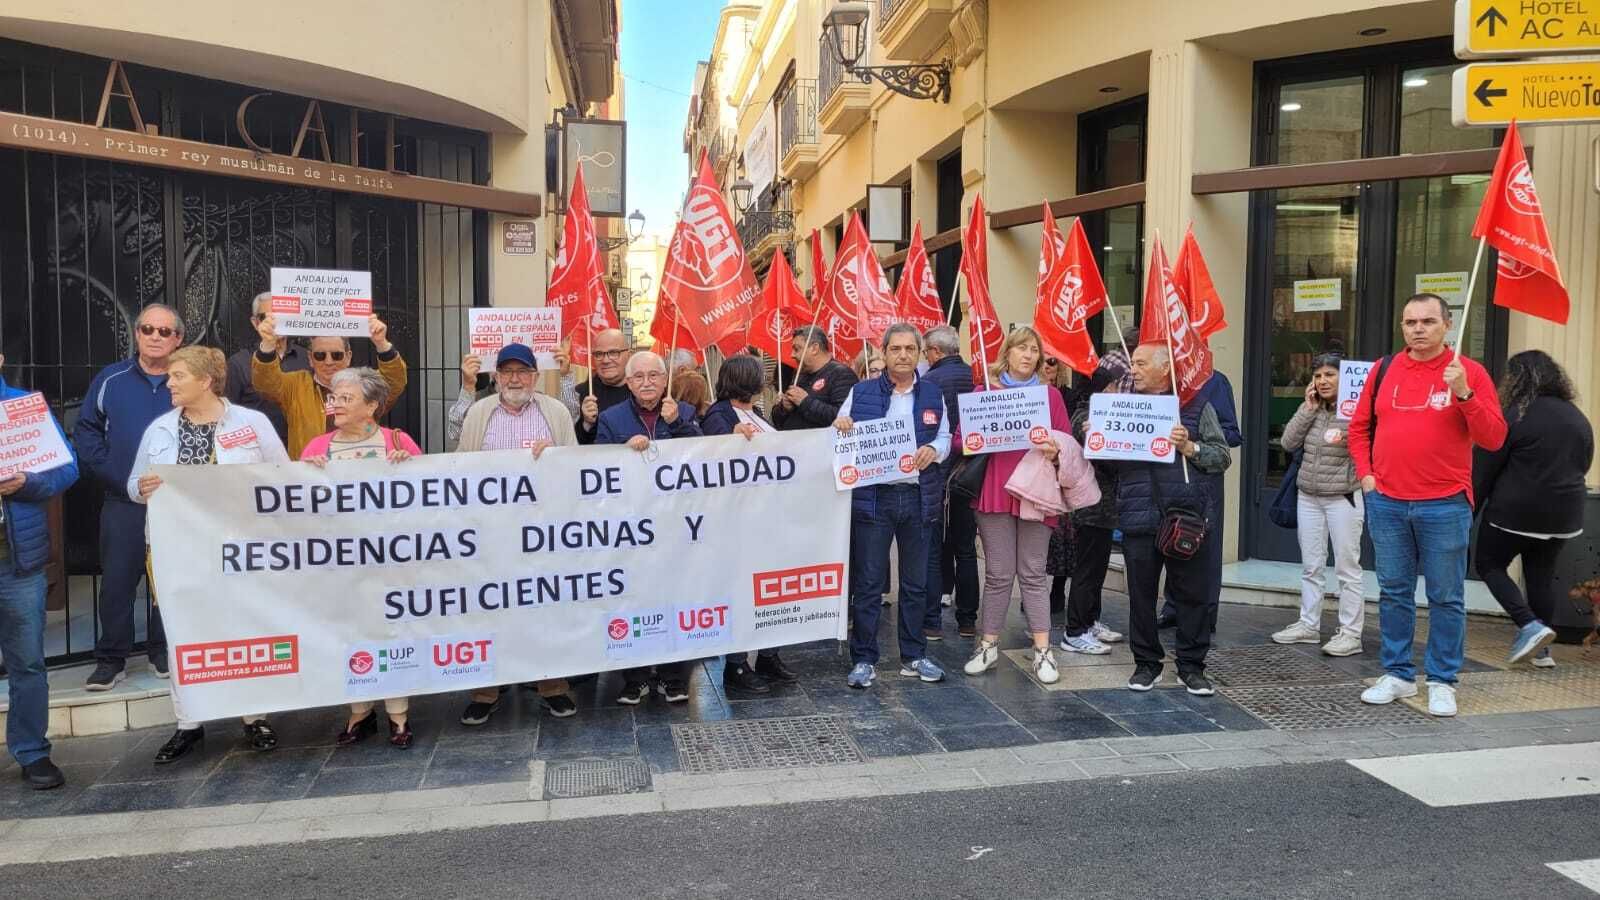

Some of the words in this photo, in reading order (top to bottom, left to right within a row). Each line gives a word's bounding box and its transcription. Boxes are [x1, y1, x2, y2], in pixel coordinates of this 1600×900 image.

[1520, 0, 1588, 15] HOTEL
[1520, 18, 1564, 39] AC
[1523, 75, 1556, 83] HOTEL
[12, 123, 90, 147] (1014).
[105, 137, 169, 158] Primer
[181, 150, 211, 166] rey
[220, 156, 295, 176] musulmán
[304, 167, 321, 180] de
[330, 169, 346, 184] la
[682, 193, 741, 271] UGT
[295, 275, 348, 284] ANDALUCÍA
[283, 286, 309, 294] TIENE
[312, 287, 325, 295] UN
[1055, 271, 1083, 321] UGT
[301, 298, 313, 306] DE
[305, 310, 340, 318] PLAZAS
[478, 312, 532, 321] ANDALUCÍA
[286, 320, 359, 329] RESIDENCIALES
[476, 324, 502, 333] COLA
[520, 322, 556, 332] ESPAÑA
[472, 335, 501, 344] CCOO
[512, 335, 523, 344] EN
[1350, 379, 1365, 387] LA
[5, 396, 42, 411] CCOO
[865, 424, 879, 435] DEL
[895, 419, 905, 430] EN
[980, 420, 1031, 433] +8.000
[1104, 420, 1155, 434] 33.000
[860, 438, 878, 451] PARA
[880, 436, 888, 447] LA
[890, 433, 912, 444] AYUDA
[1105, 440, 1124, 449] UGT
[862, 450, 897, 465] DOMICILIO
[254, 475, 537, 514] DEPENDENCIA
[580, 466, 622, 496] DE
[655, 455, 796, 491] CALIDAD
[222, 529, 477, 573] RESIDENCIAS
[522, 518, 655, 553] DIGNAS
[685, 515, 704, 541] Y
[760, 570, 838, 599] CCOO
[385, 568, 625, 619] SUFICIENTES
[679, 605, 729, 632] UGT
[755, 606, 791, 619] federación
[793, 604, 801, 612] de
[641, 614, 664, 626] UJP
[755, 615, 798, 630] pensionistas
[182, 643, 270, 670] CCOO
[389, 646, 415, 660] UJP
[433, 640, 493, 667] UGT
[183, 667, 250, 681] PENSIONISTAS
